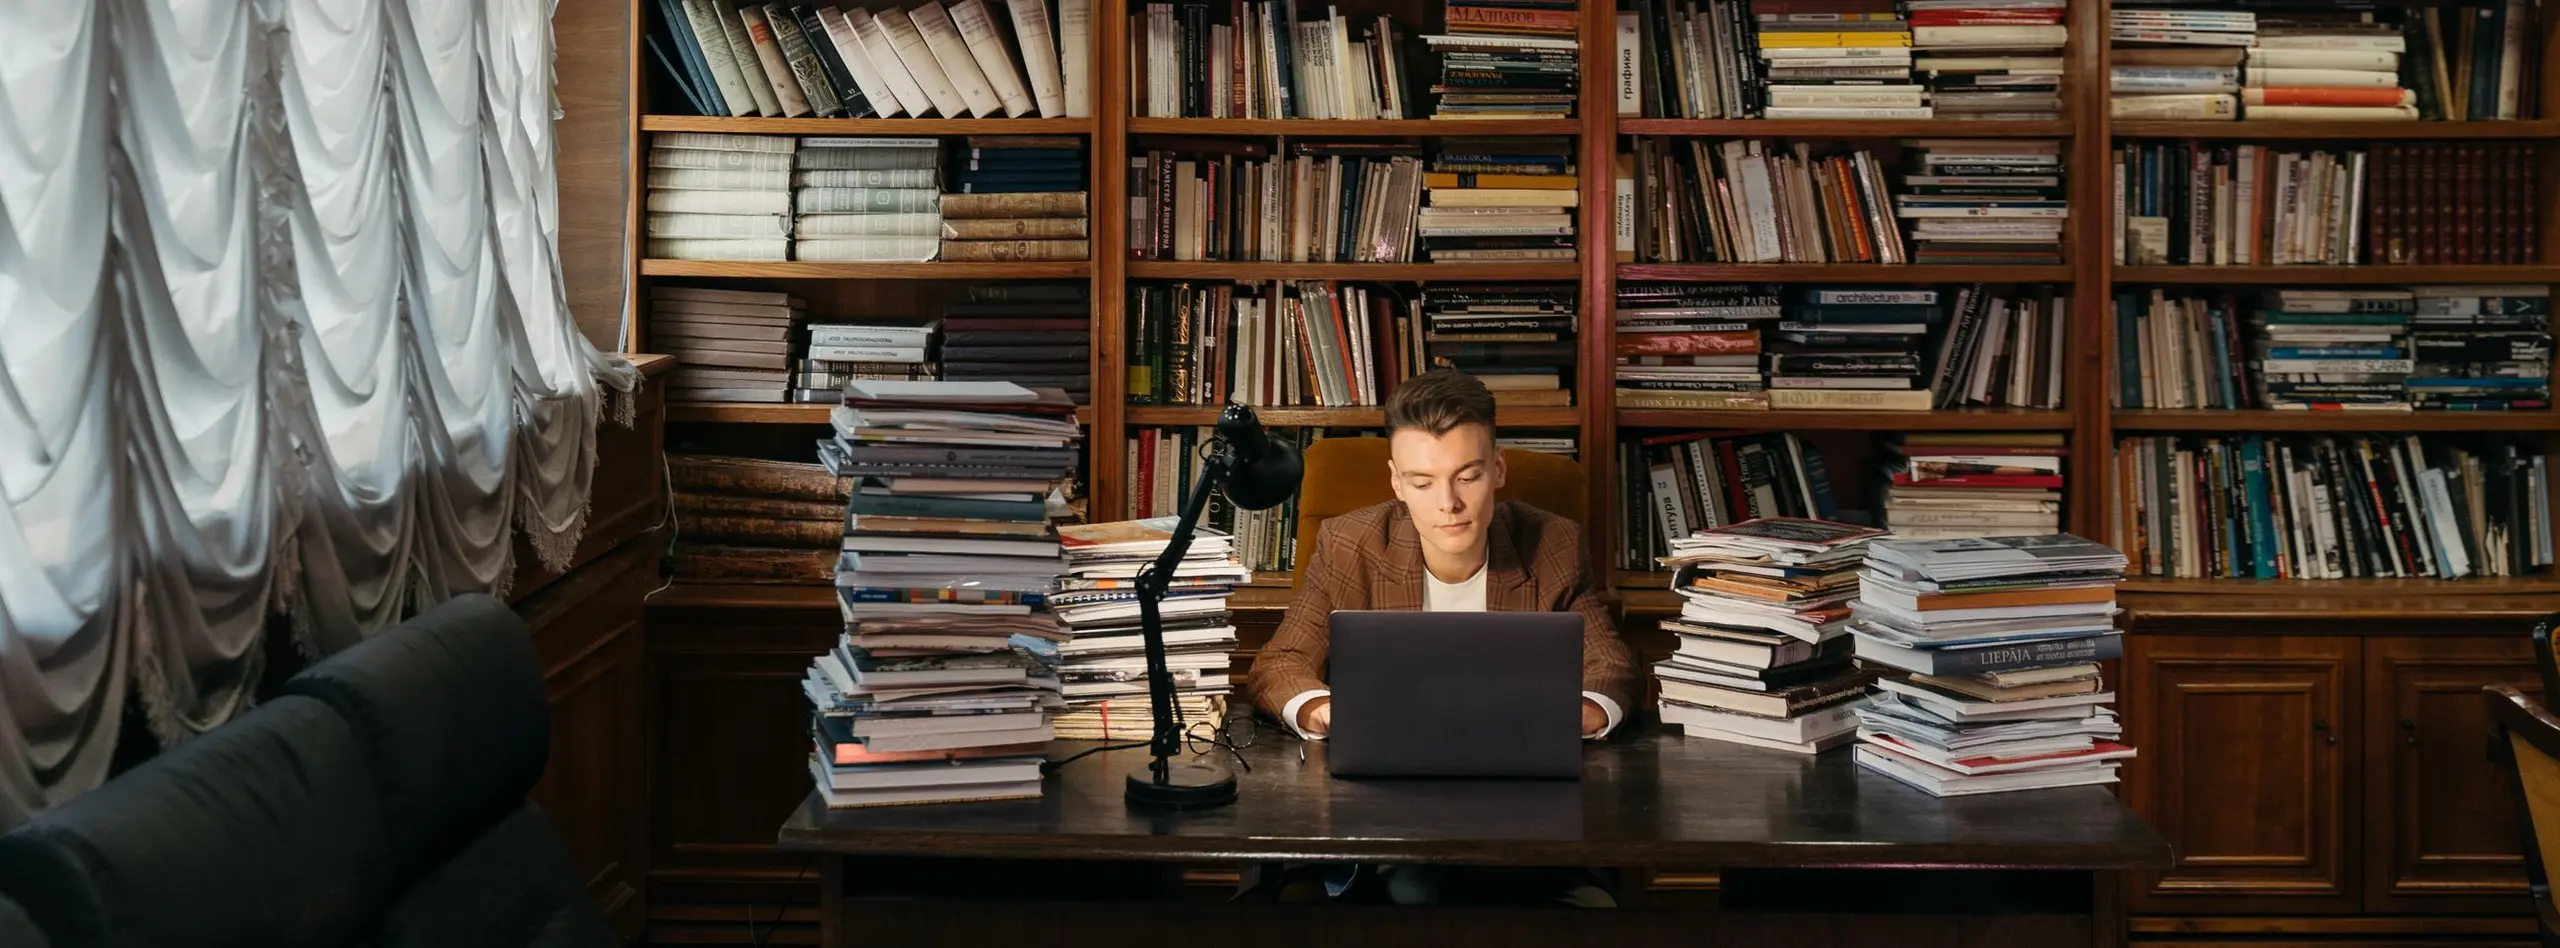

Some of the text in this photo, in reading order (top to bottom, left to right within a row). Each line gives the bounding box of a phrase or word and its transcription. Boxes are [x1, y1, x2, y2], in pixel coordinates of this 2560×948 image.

[1620, 48, 1634, 100] графика
[1624, 194, 1632, 237] Искусство
[1676, 298, 1726, 307] Splendeurs
[1743, 296, 1779, 306] PARIS
[1836, 293, 1901, 304] architecture
[1736, 450, 1750, 481] France
[1744, 484, 1754, 494] de
[1663, 496, 1680, 538] ьптура
[1980, 648, 2032, 665] LIEPĀJA
